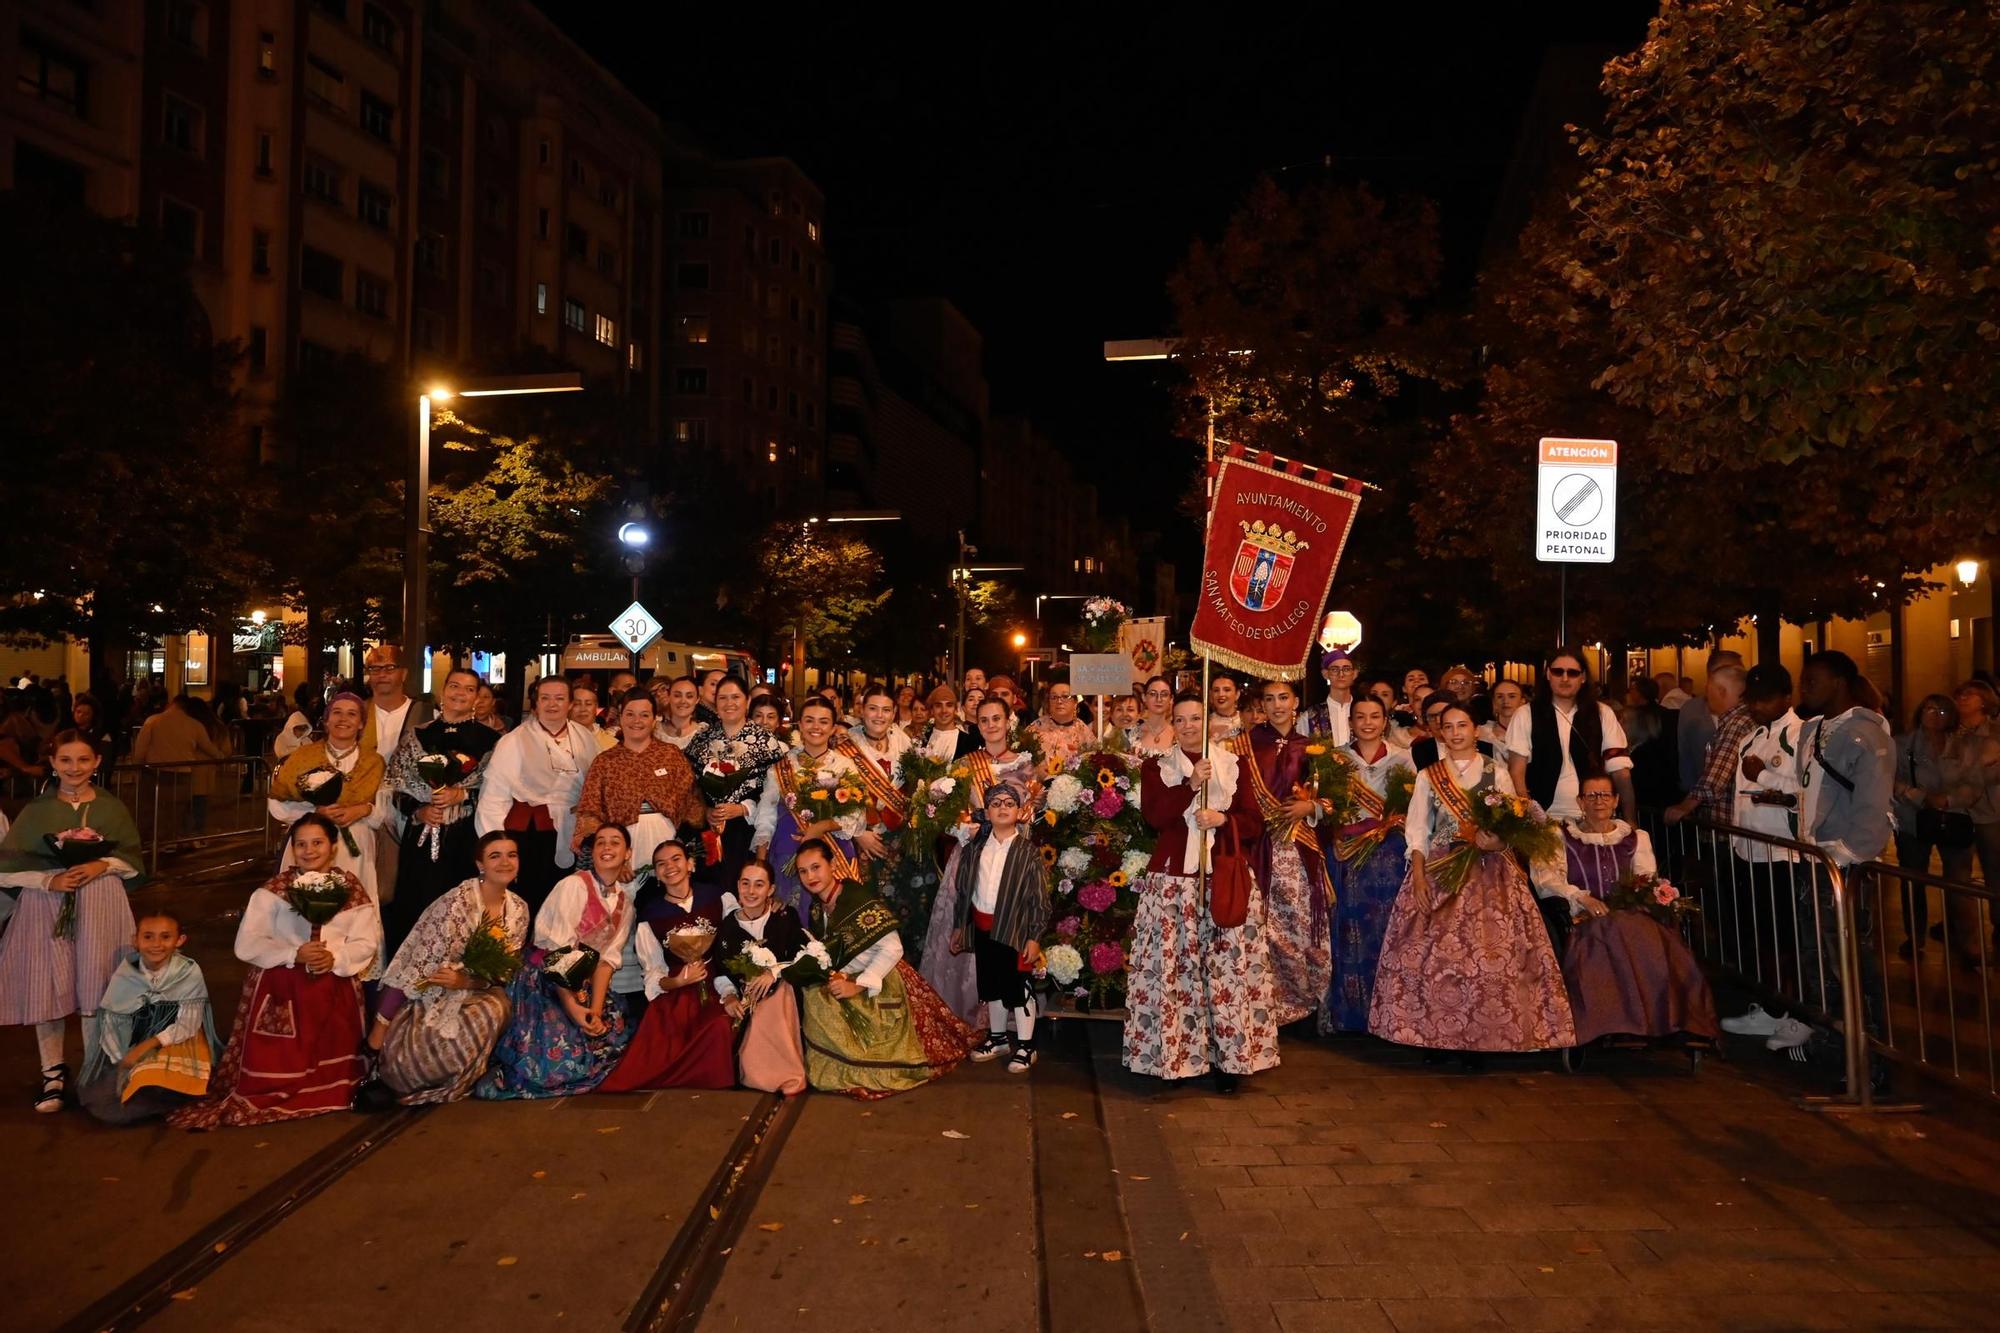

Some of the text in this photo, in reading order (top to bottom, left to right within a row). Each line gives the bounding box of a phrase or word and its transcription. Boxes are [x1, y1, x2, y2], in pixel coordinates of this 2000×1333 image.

[1548, 446, 1608, 458] ATENCIÓN
[1236, 492, 1327, 533] AYUNTAMIENTO
[1546, 530, 1607, 541] PRIORIDAD
[1546, 544, 1606, 555] PEATONAL
[1205, 570, 1310, 640] SAN MATEO DE GALLEGO
[624, 618, 647, 636] 30
